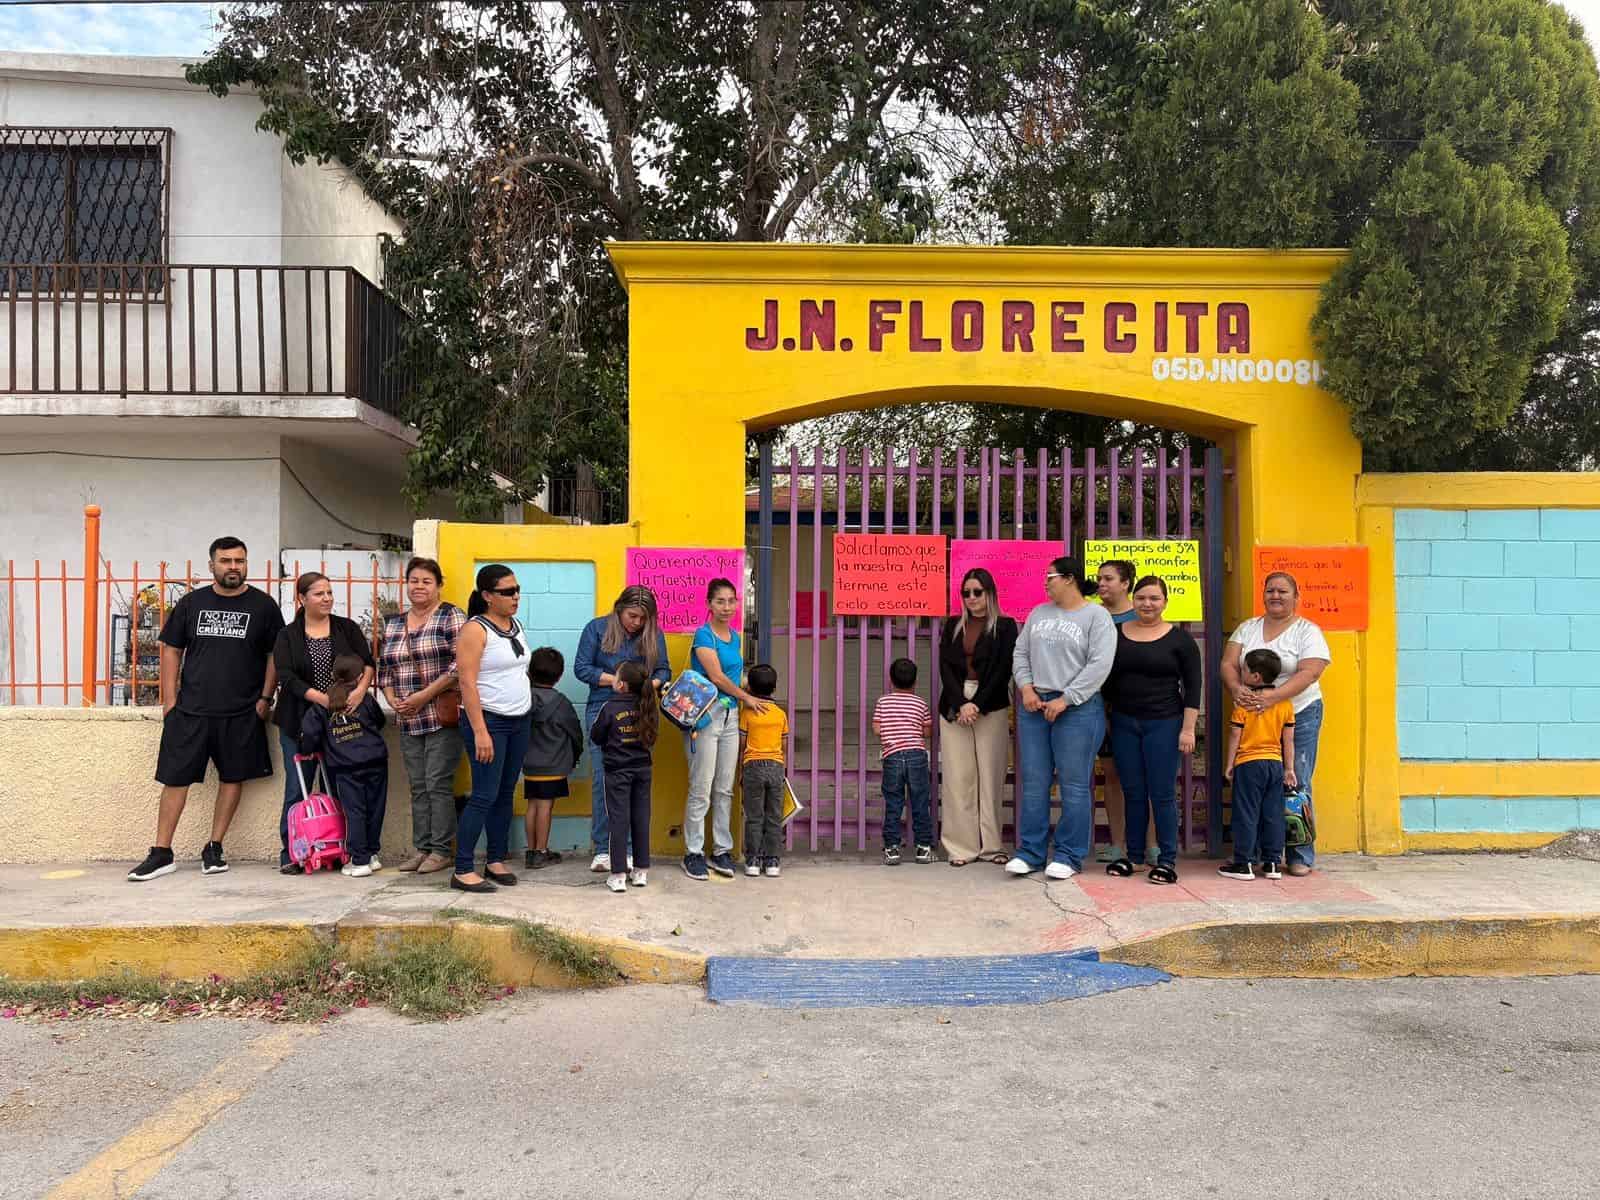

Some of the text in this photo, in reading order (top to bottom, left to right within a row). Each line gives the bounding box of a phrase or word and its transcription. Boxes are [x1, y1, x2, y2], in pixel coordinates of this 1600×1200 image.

[745, 300, 1250, 354] J.N. FLORECITA
[915, 544, 937, 561] que
[1156, 543, 1172, 553] de
[633, 552, 739, 574] Queremos que
[836, 559, 849, 572] la
[853, 559, 904, 573] maestra
[910, 560, 945, 578] Aglae
[637, 571, 650, 586] la
[835, 578, 928, 592] termine este
[836, 597, 932, 611] ciclo escolar.
[204, 612, 220, 621] NO
[222, 613, 243, 623] HAY
[198, 626, 246, 637] CRISTIANO
